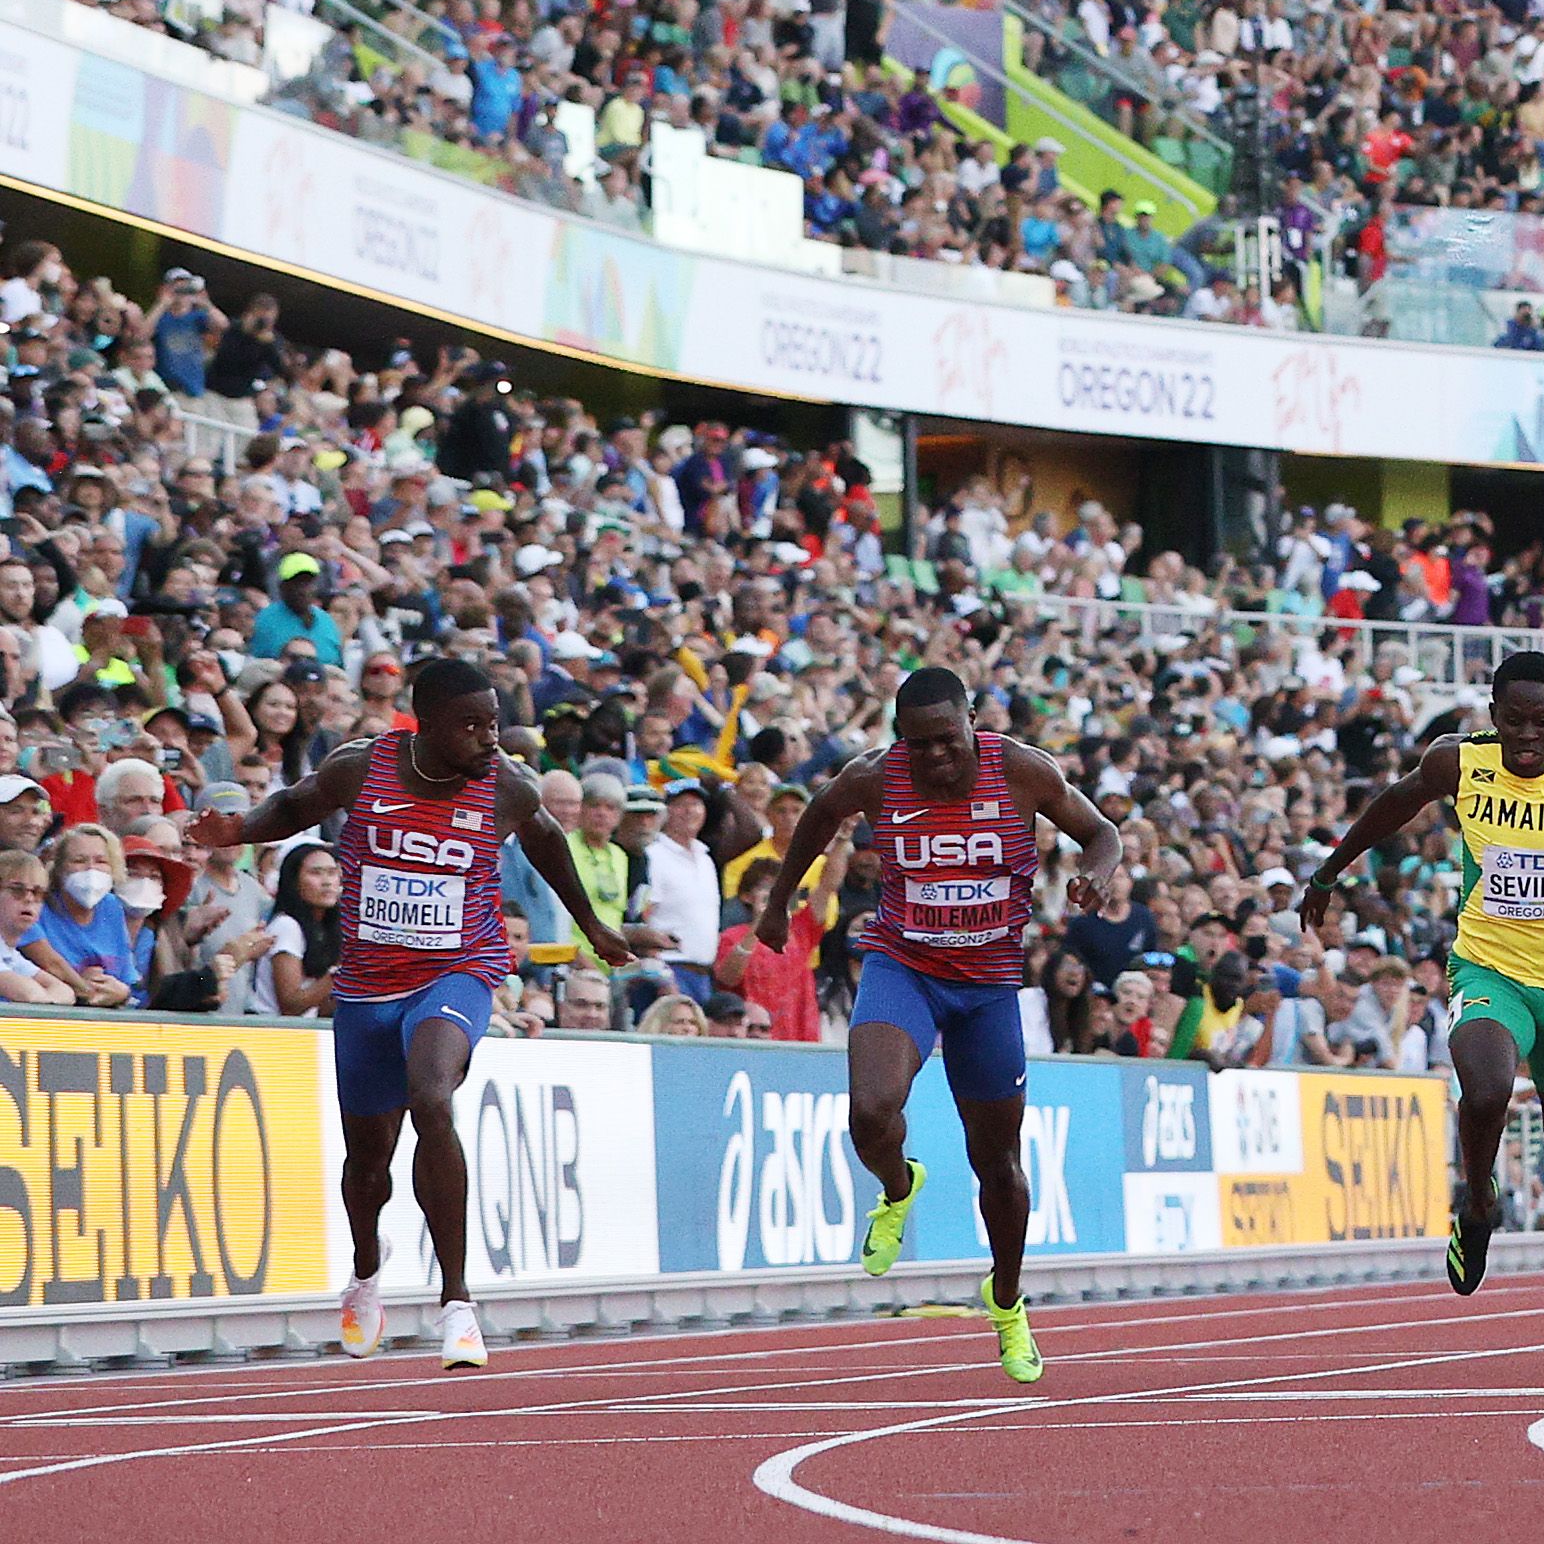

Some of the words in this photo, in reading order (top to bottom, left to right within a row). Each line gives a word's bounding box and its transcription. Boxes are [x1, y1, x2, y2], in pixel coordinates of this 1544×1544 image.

[367, 825, 475, 872] USA
[895, 832, 1003, 869] USA
[390, 876, 448, 898] TDK
[938, 881, 995, 901] TDK
[365, 897, 456, 927] BROMELL
[912, 901, 1002, 927] COLEMAN
[372, 930, 443, 946] OREGON22
[921, 931, 992, 946] OREGON22
[478, 1078, 584, 1277] QNB
